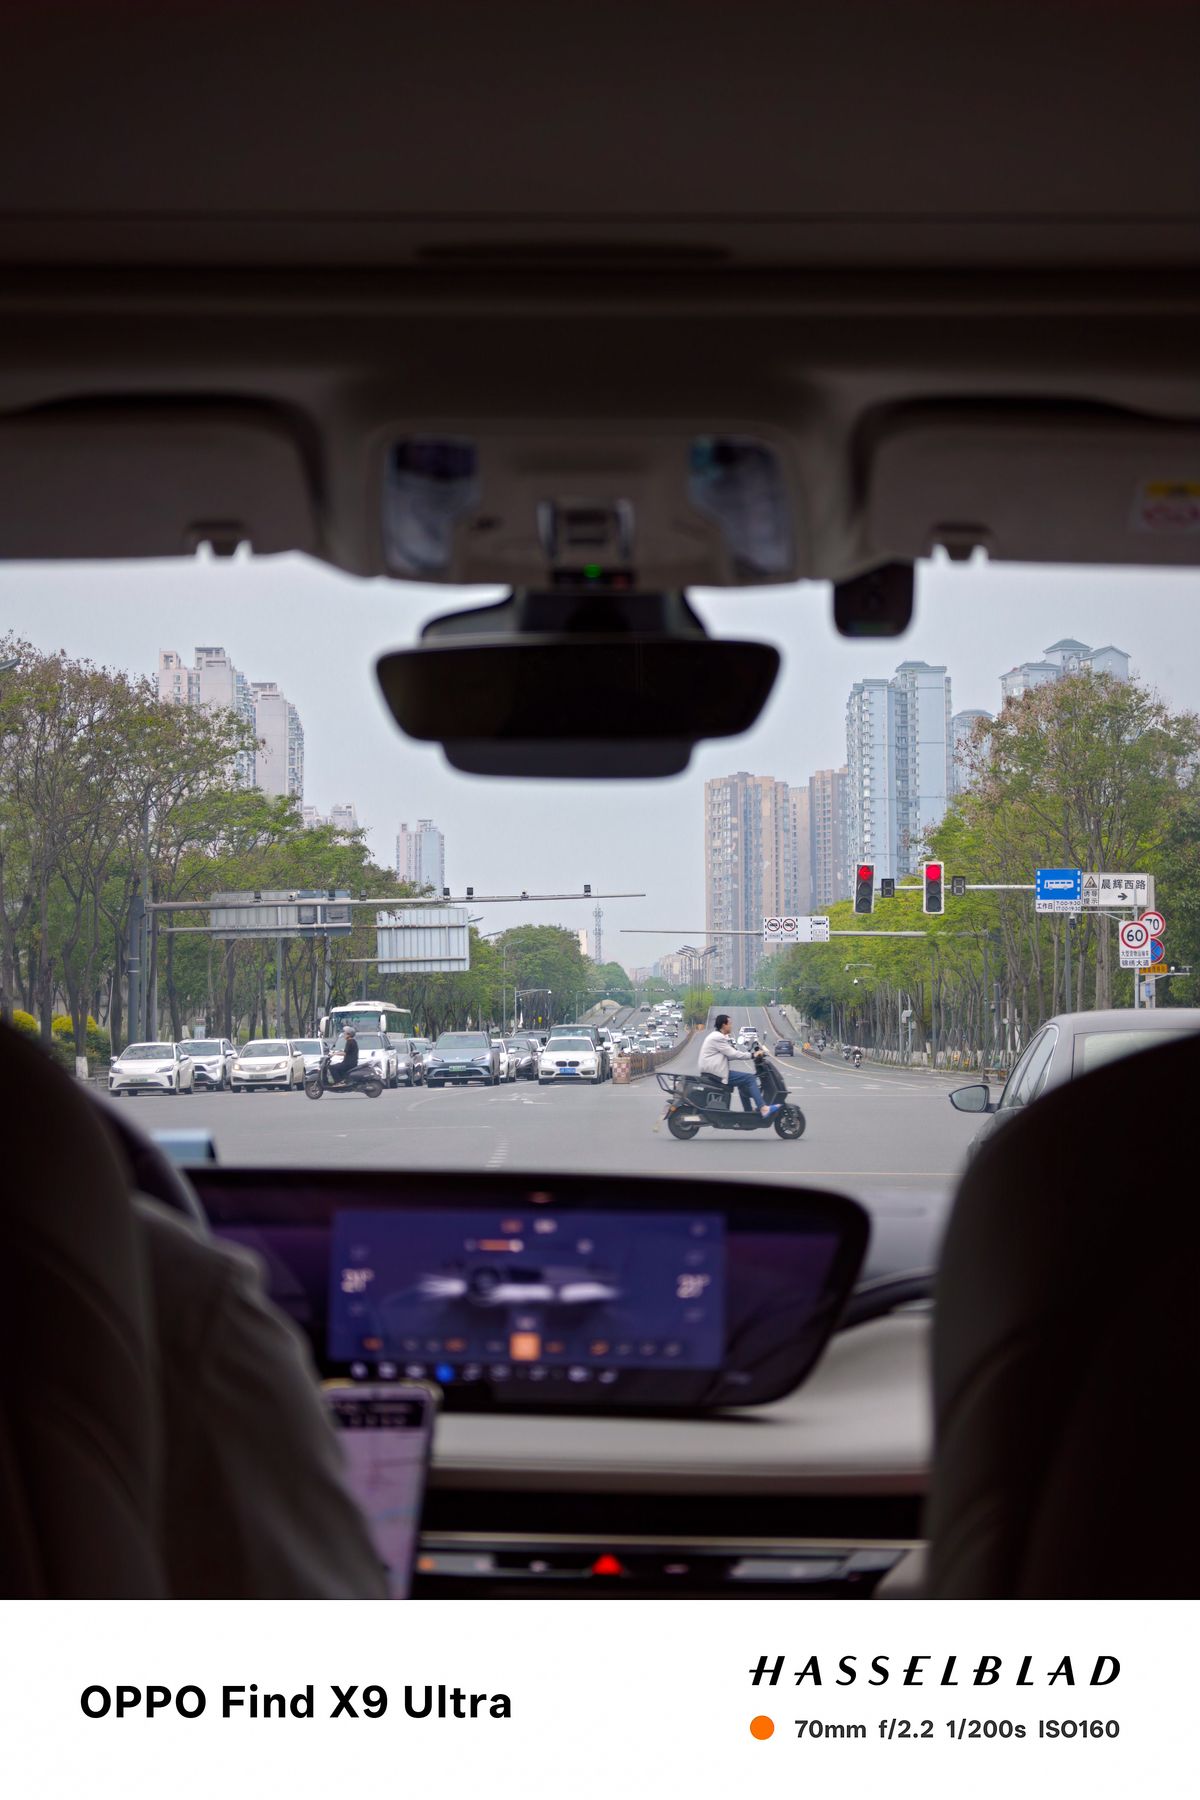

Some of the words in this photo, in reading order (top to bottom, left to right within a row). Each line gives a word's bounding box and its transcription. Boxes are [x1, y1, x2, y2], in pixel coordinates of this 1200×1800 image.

[1101, 879, 1146, 890] 晨辉西路
[1036, 902, 1053, 910] 工作日
[1126, 929, 1144, 942] 60
